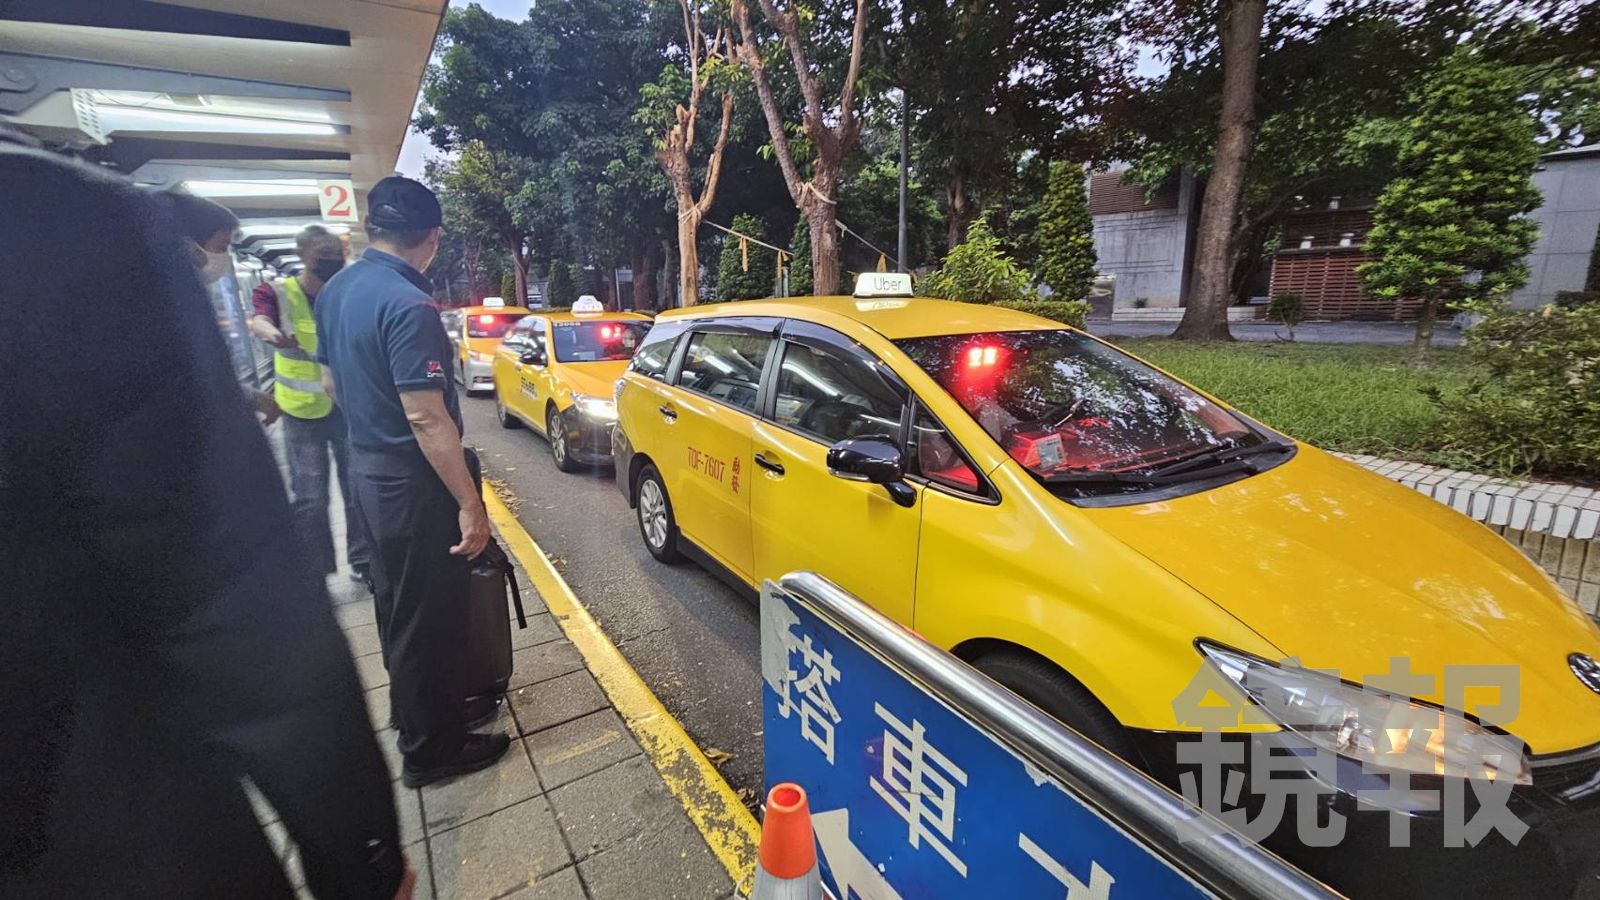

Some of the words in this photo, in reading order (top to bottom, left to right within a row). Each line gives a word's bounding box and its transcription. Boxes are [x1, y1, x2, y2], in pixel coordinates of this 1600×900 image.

[323, 185, 351, 217] 2
[873, 276, 902, 291] Uber
[687, 446, 726, 483] TDF-7607
